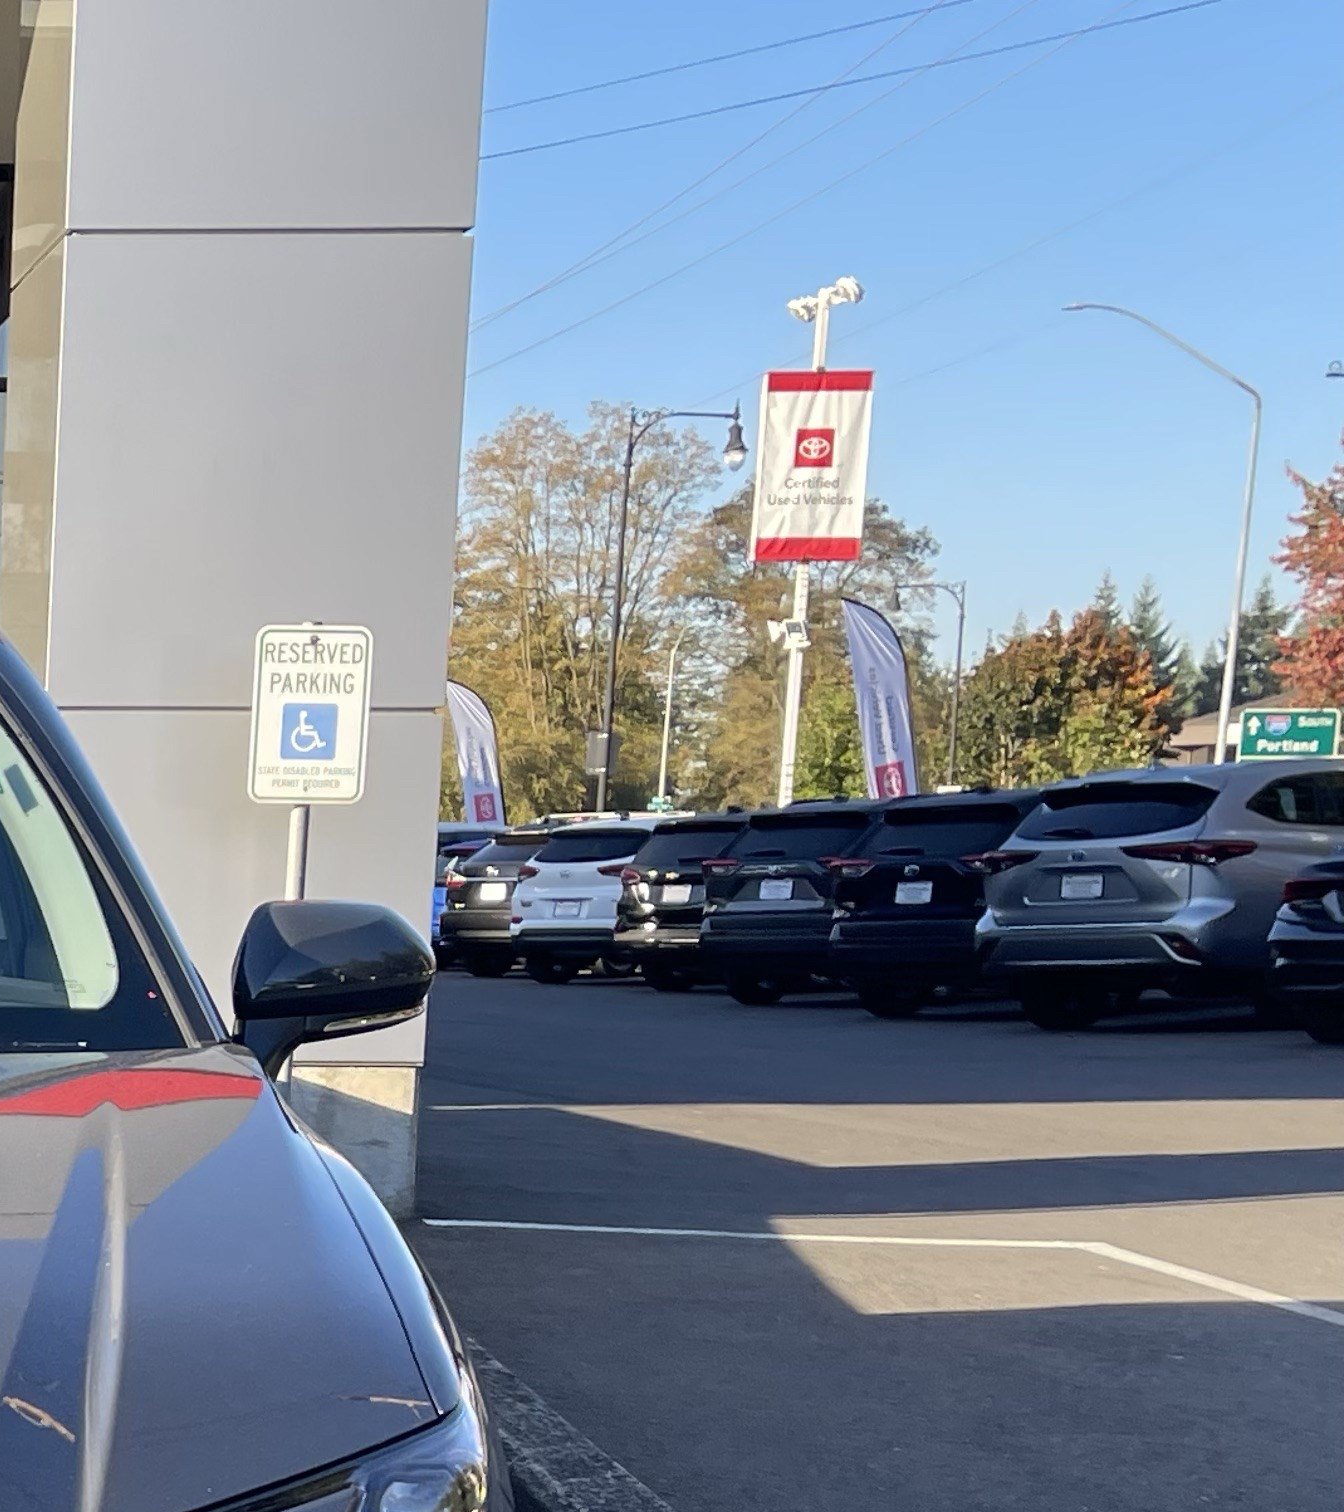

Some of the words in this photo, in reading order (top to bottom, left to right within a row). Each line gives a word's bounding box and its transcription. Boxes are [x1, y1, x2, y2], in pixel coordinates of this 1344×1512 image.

[784, 476, 840, 490] Certified
[264, 642, 363, 665] RESERVED
[269, 672, 355, 695] PARKING
[1256, 739, 1319, 753] Portland
